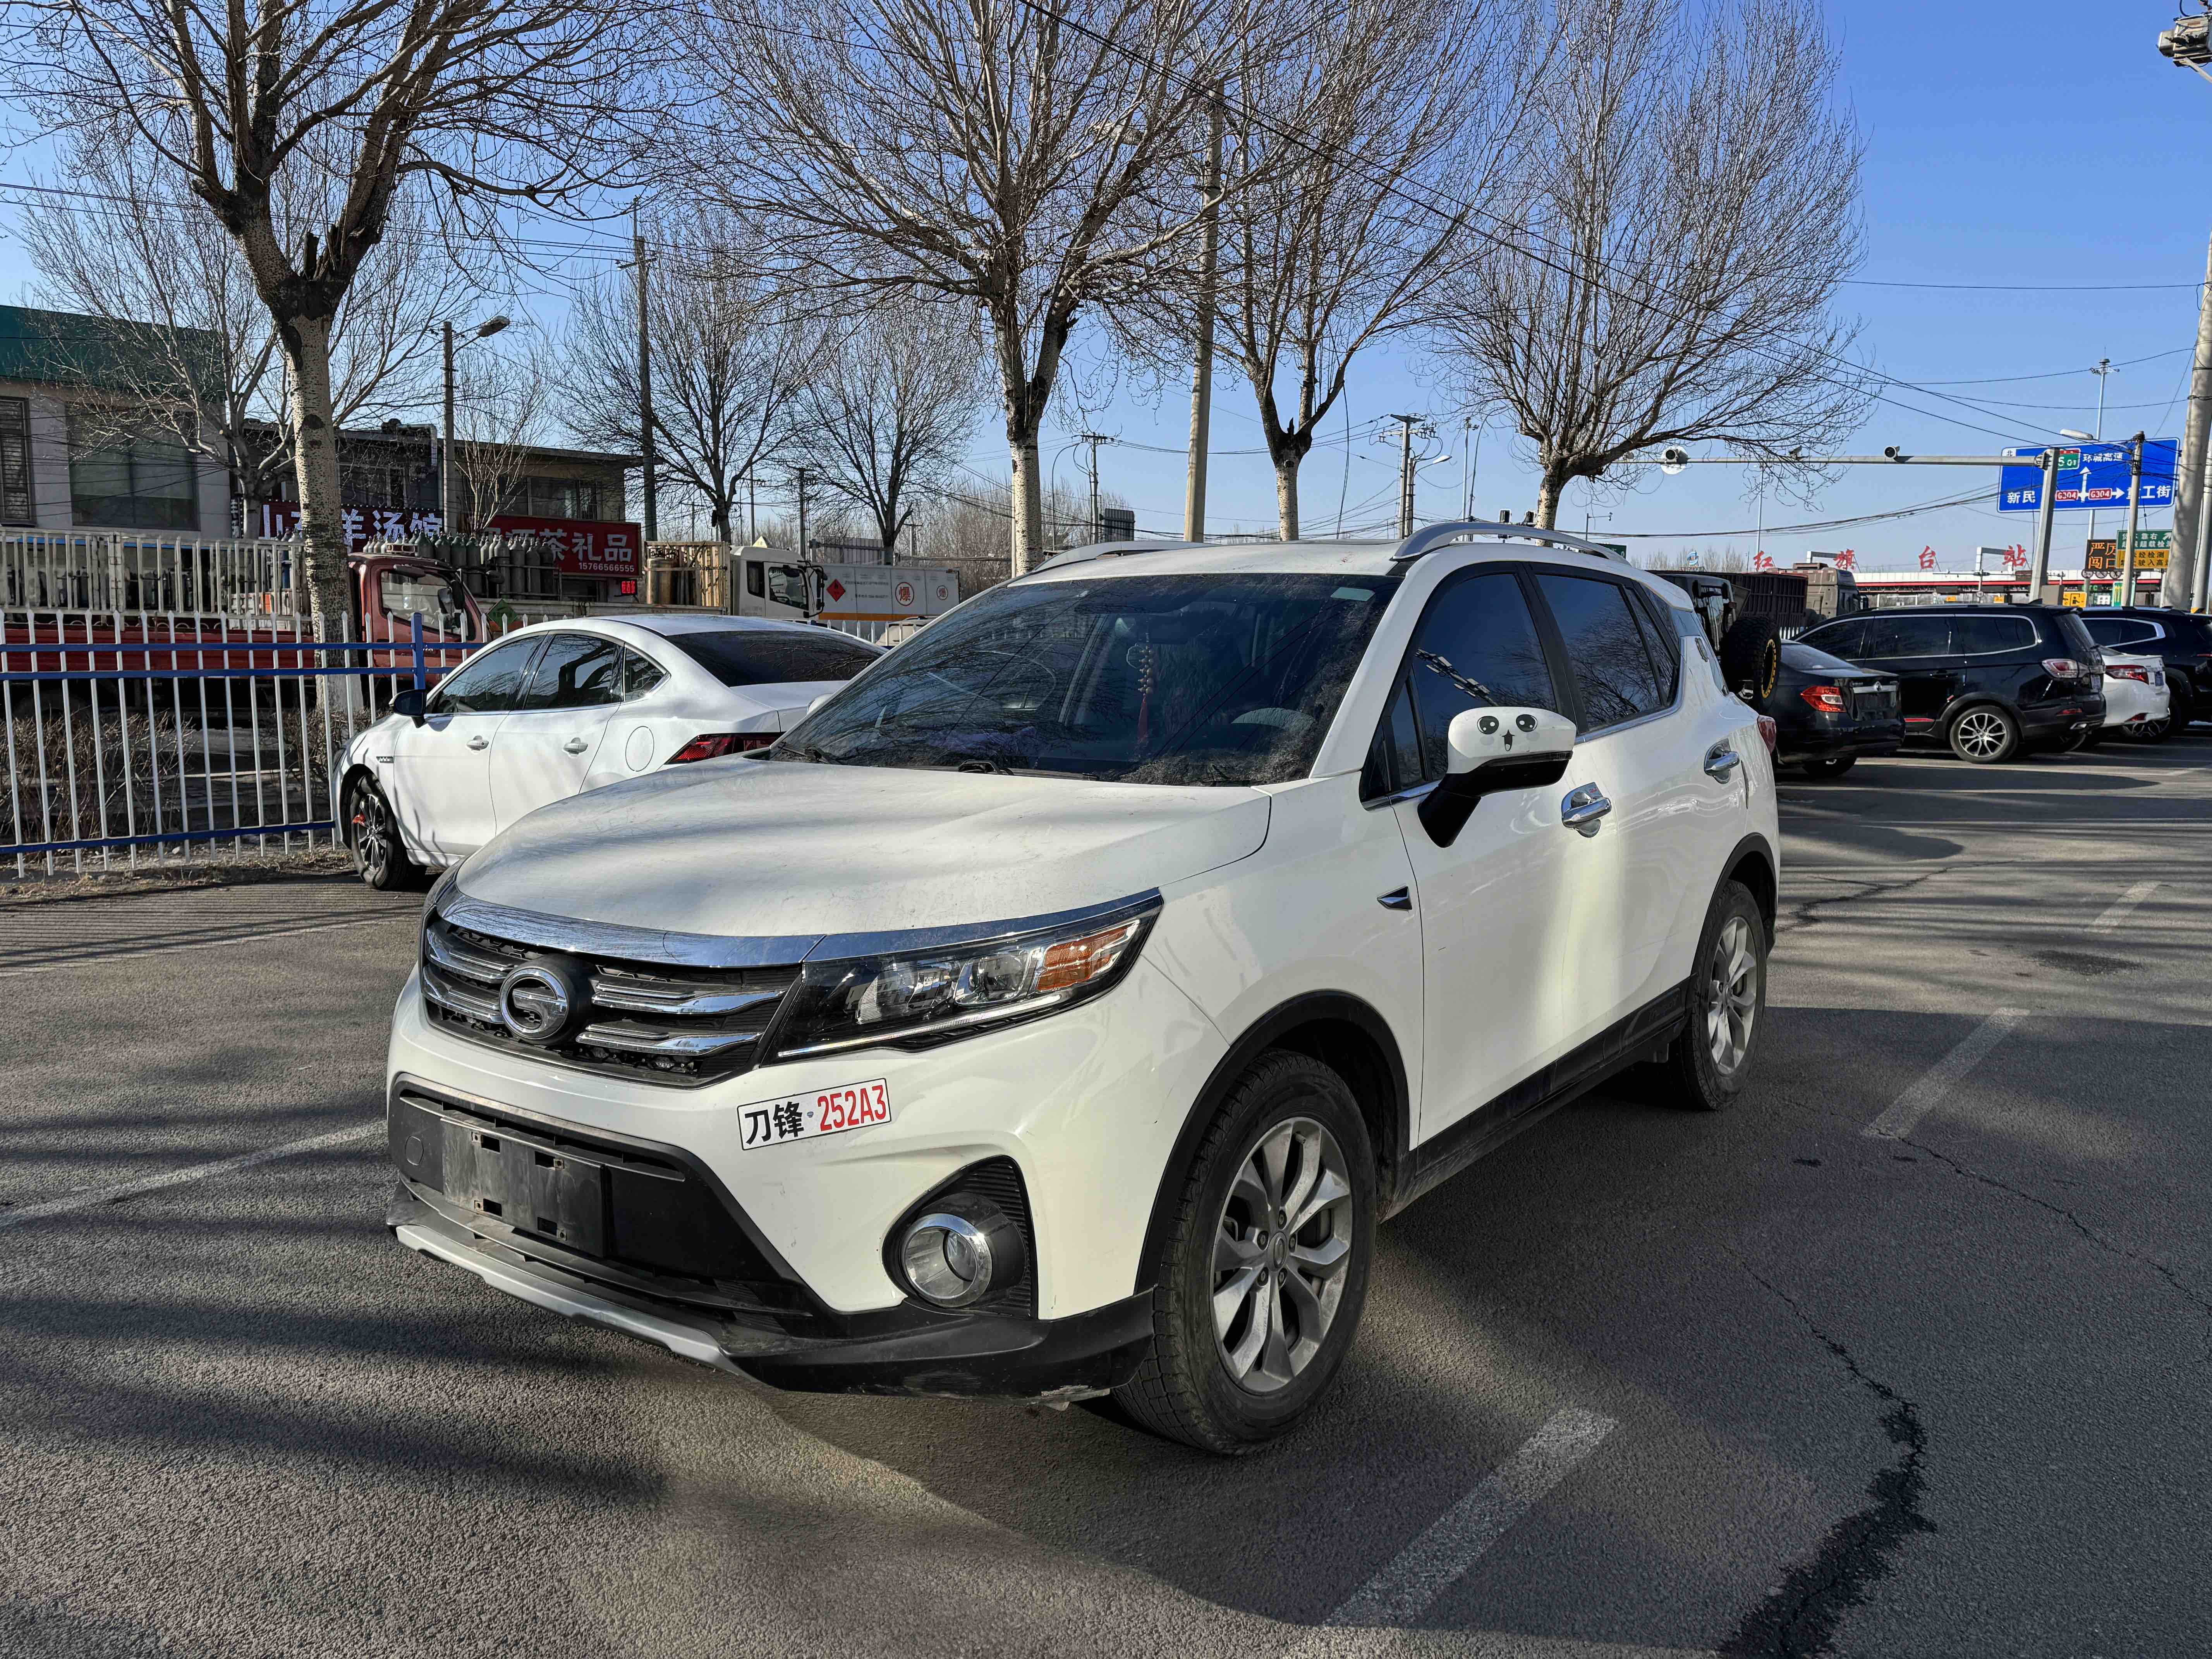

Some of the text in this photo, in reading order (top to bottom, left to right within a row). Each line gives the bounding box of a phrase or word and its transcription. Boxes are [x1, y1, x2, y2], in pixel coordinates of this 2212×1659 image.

[2007, 491, 2035, 503] 新民
[258, 505, 442, 552] 山羊汤馆
[579, 562, 634, 572] 15766566555
